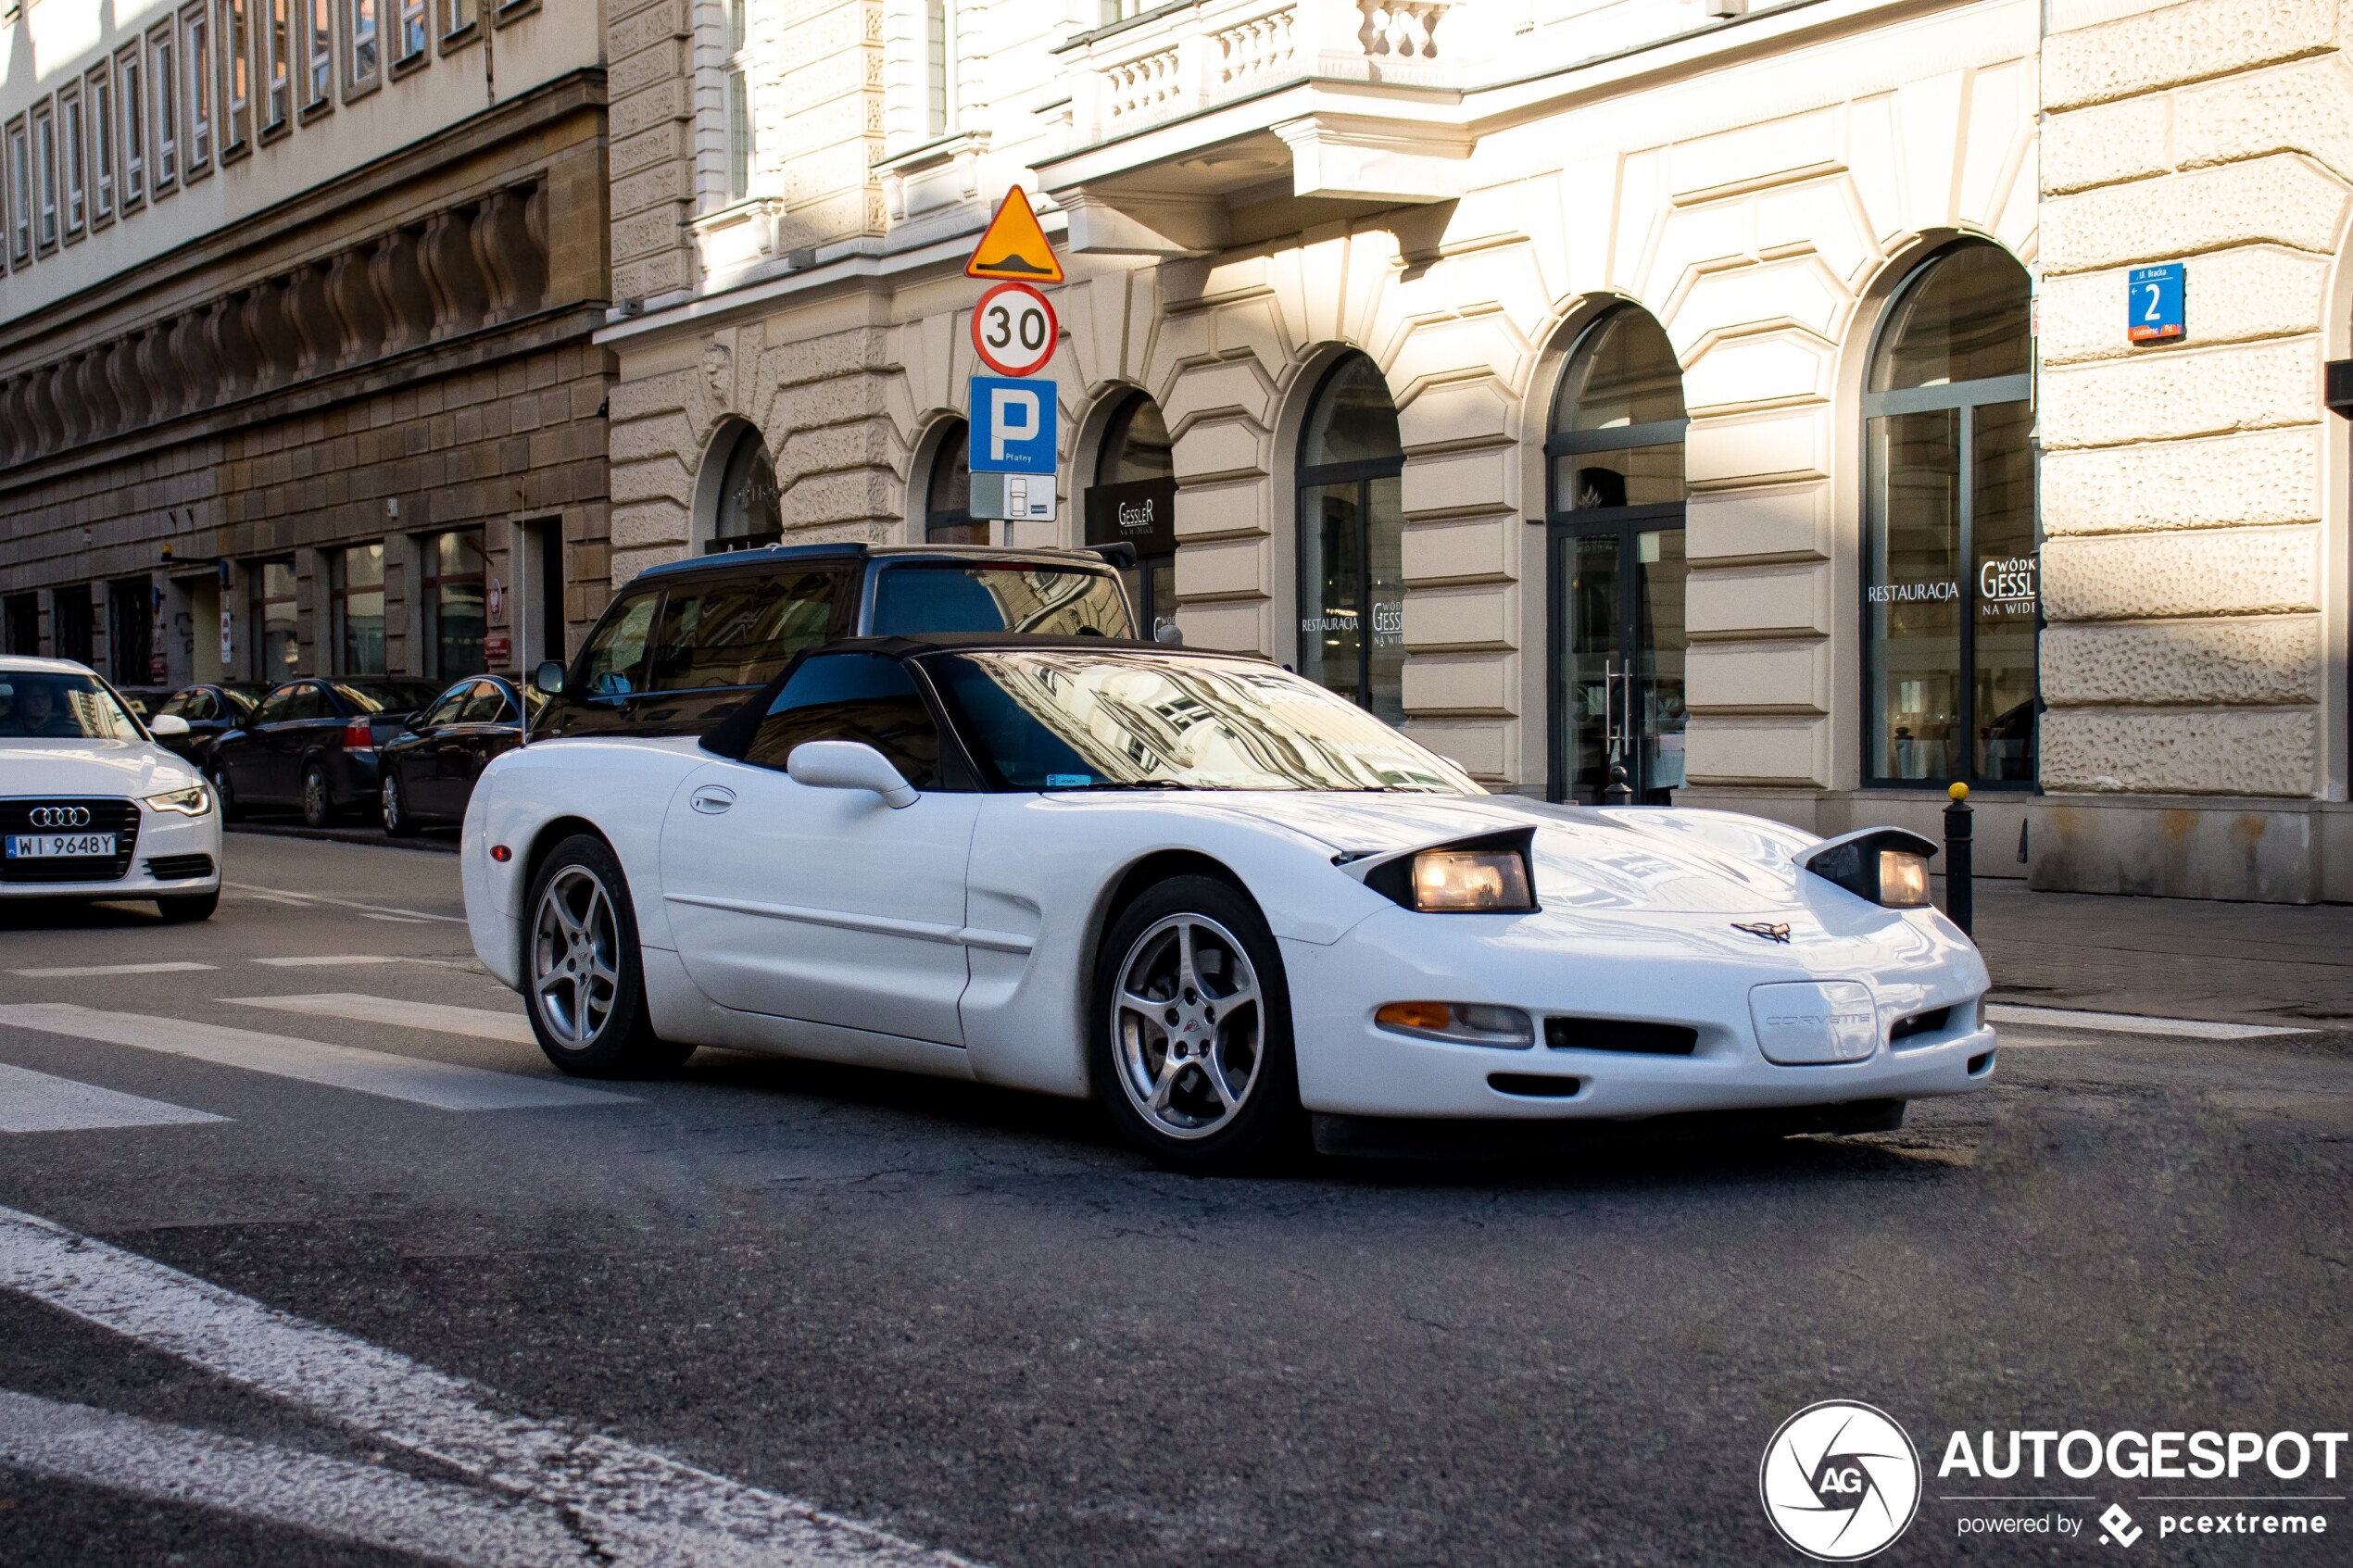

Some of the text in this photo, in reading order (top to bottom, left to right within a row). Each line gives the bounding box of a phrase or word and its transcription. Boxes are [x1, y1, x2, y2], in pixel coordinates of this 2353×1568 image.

[2147, 268, 2167, 278] Bracka
[2145, 283, 2160, 321] 2
[987, 306, 1045, 351] 30
[991, 388, 1039, 460] P
[1118, 498, 1154, 526] GESSLER
[1996, 558, 2035, 572] WÓDK
[1981, 560, 2035, 598] GESSL
[1869, 582, 1959, 603] RESTAURACJA
[1383, 600, 1402, 611] WÓD
[1982, 605, 1999, 616] NA
[1302, 617, 1359, 633] RESTAURACJA
[19, 835, 111, 855] WI 9648Y
[1766, 1012, 1870, 1026] CORVETTE
